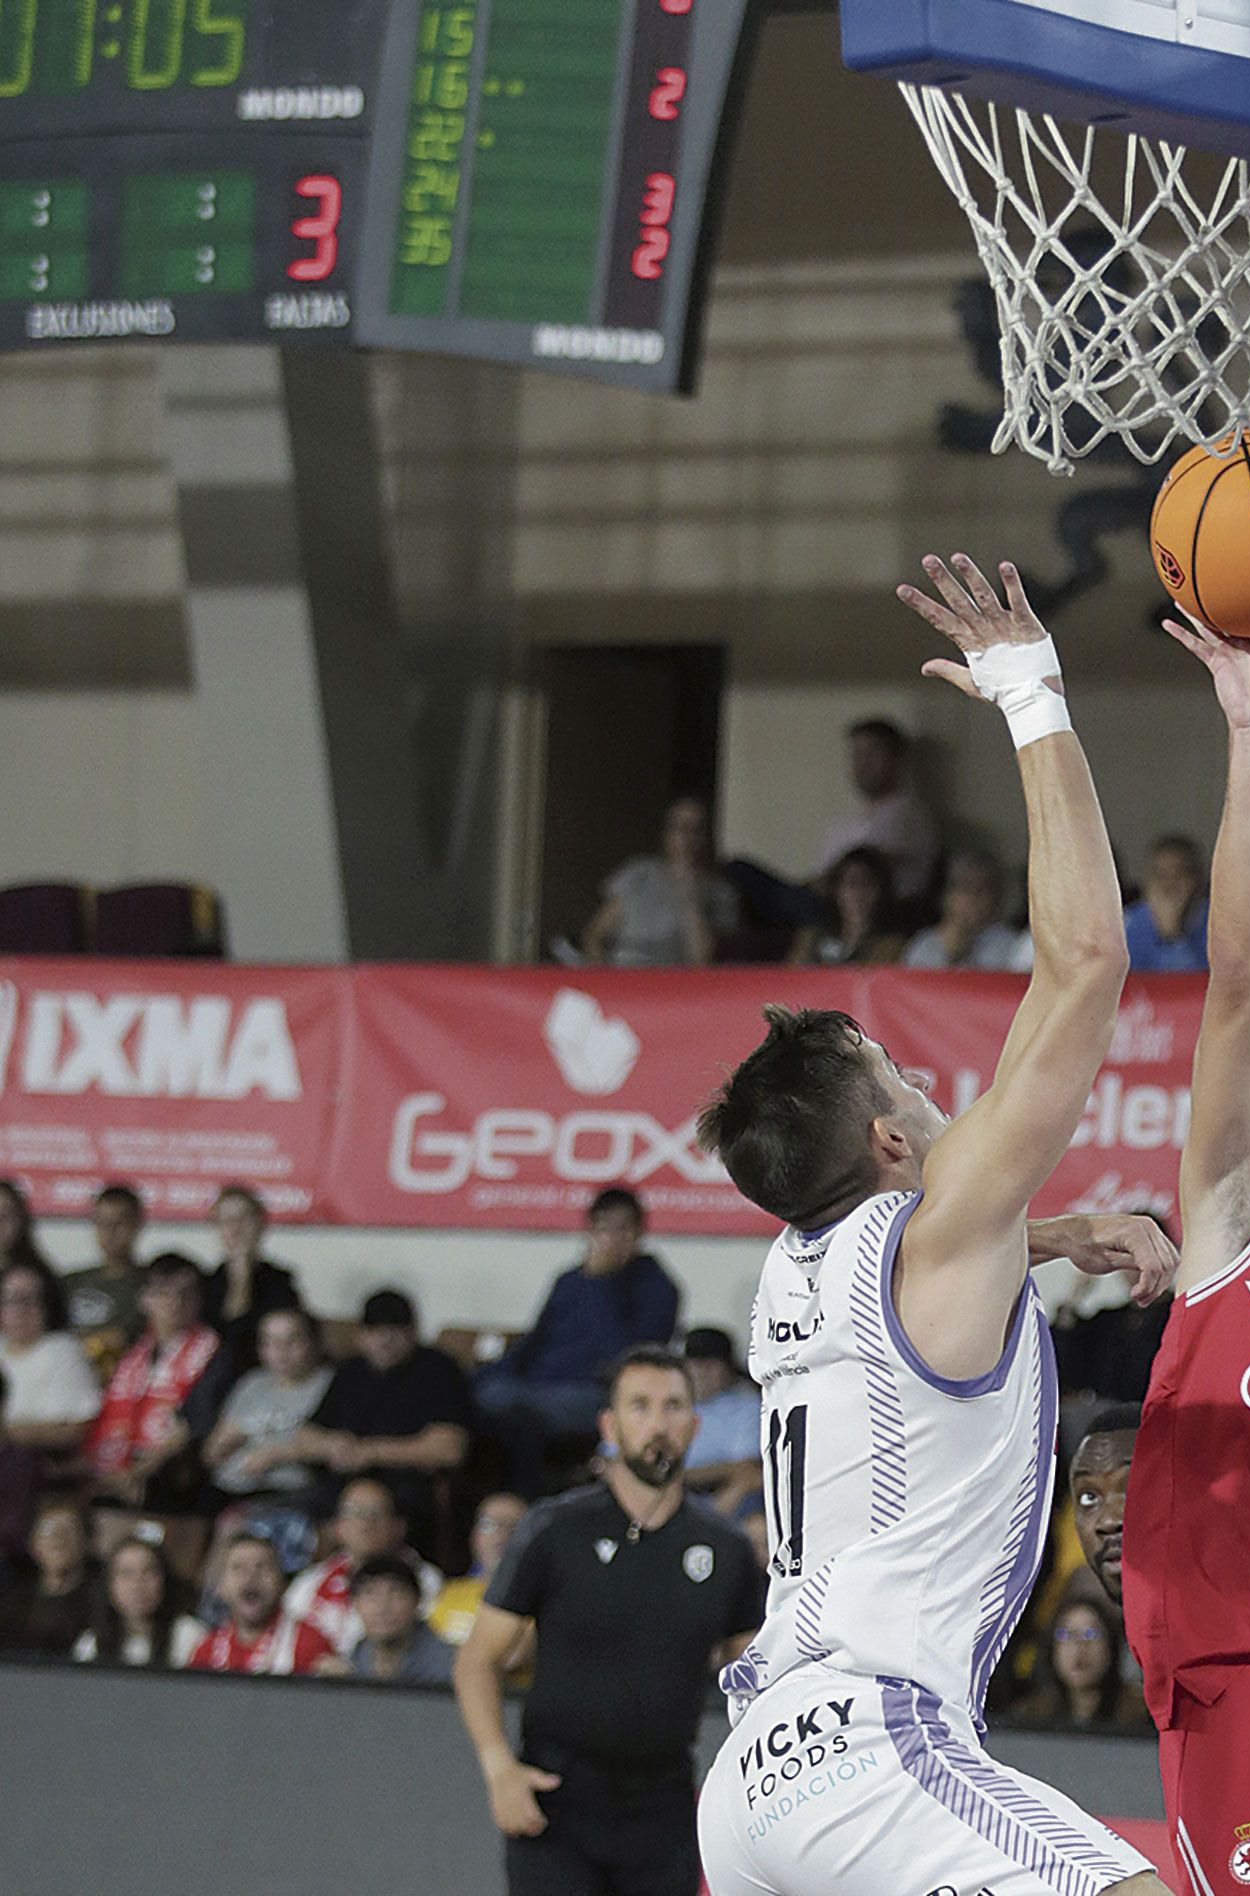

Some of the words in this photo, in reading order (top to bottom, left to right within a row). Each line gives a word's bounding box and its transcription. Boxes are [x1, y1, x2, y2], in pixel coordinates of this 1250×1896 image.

[648, 67, 688, 120] 2
[286, 175, 342, 281] 3
[639, 172, 675, 225] 3
[631, 226, 671, 279] 2
[388, 1090, 736, 1194] Geox
[740, 1697, 855, 1779] VICKY
[746, 1735, 849, 1811] FOODS
[746, 1752, 879, 1846] FUNDACIÓN
